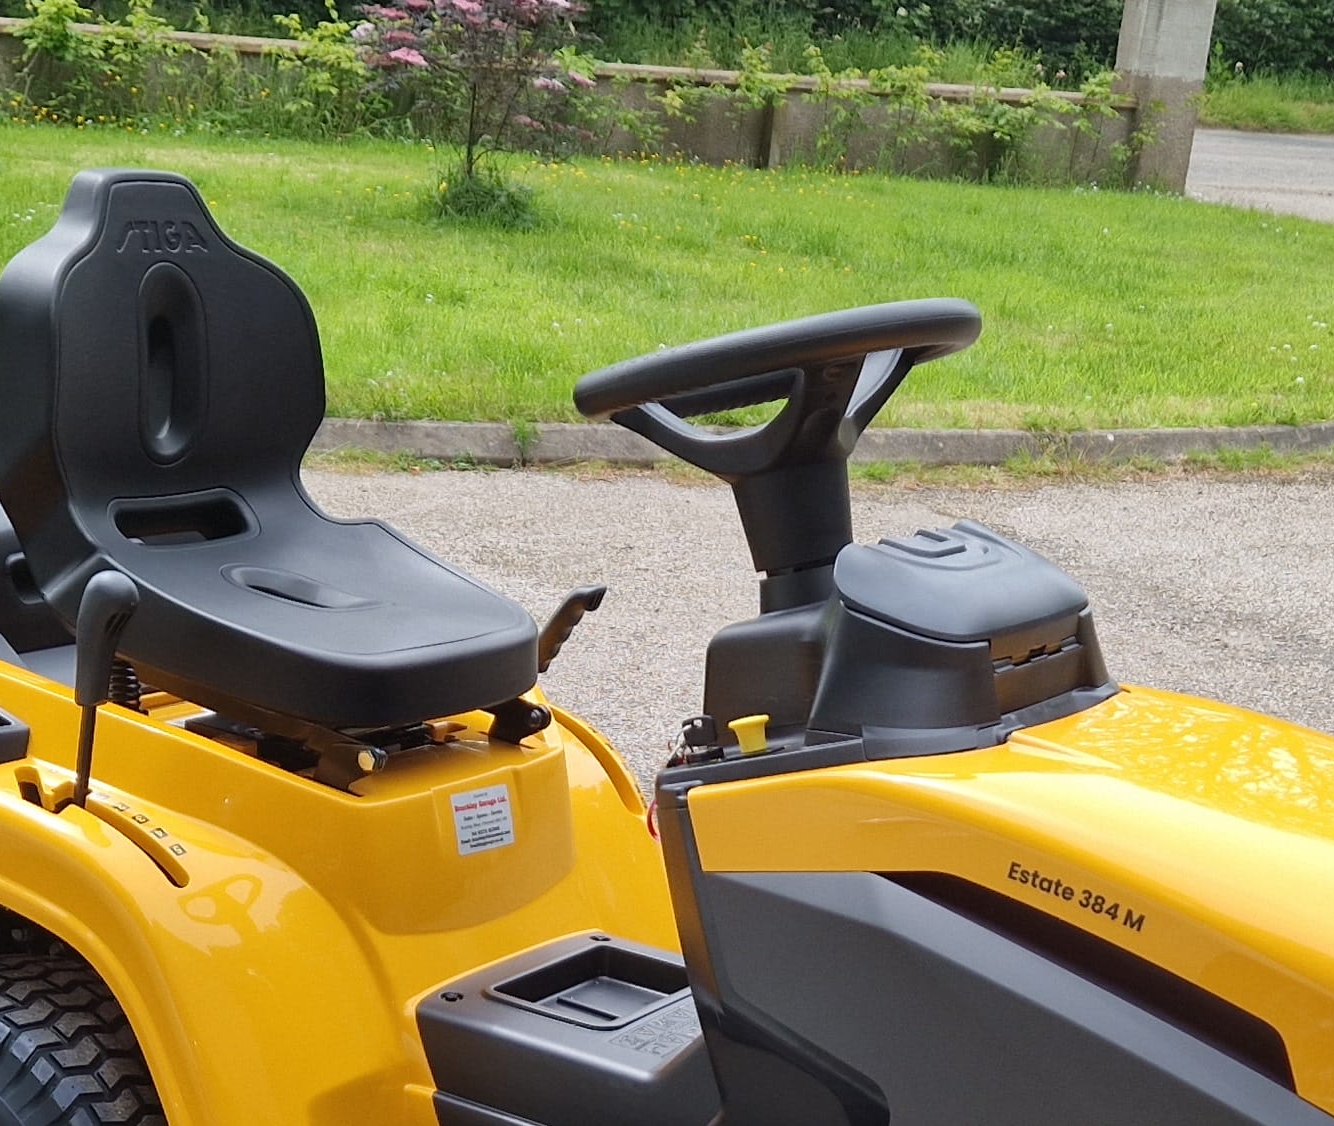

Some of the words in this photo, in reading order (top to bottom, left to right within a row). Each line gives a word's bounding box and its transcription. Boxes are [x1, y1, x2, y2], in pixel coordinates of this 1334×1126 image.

[116, 220, 208, 253] STIGA
[1007, 861, 1075, 901] Estate
[1078, 889, 1120, 920] 384
[1123, 908, 1146, 932] M
